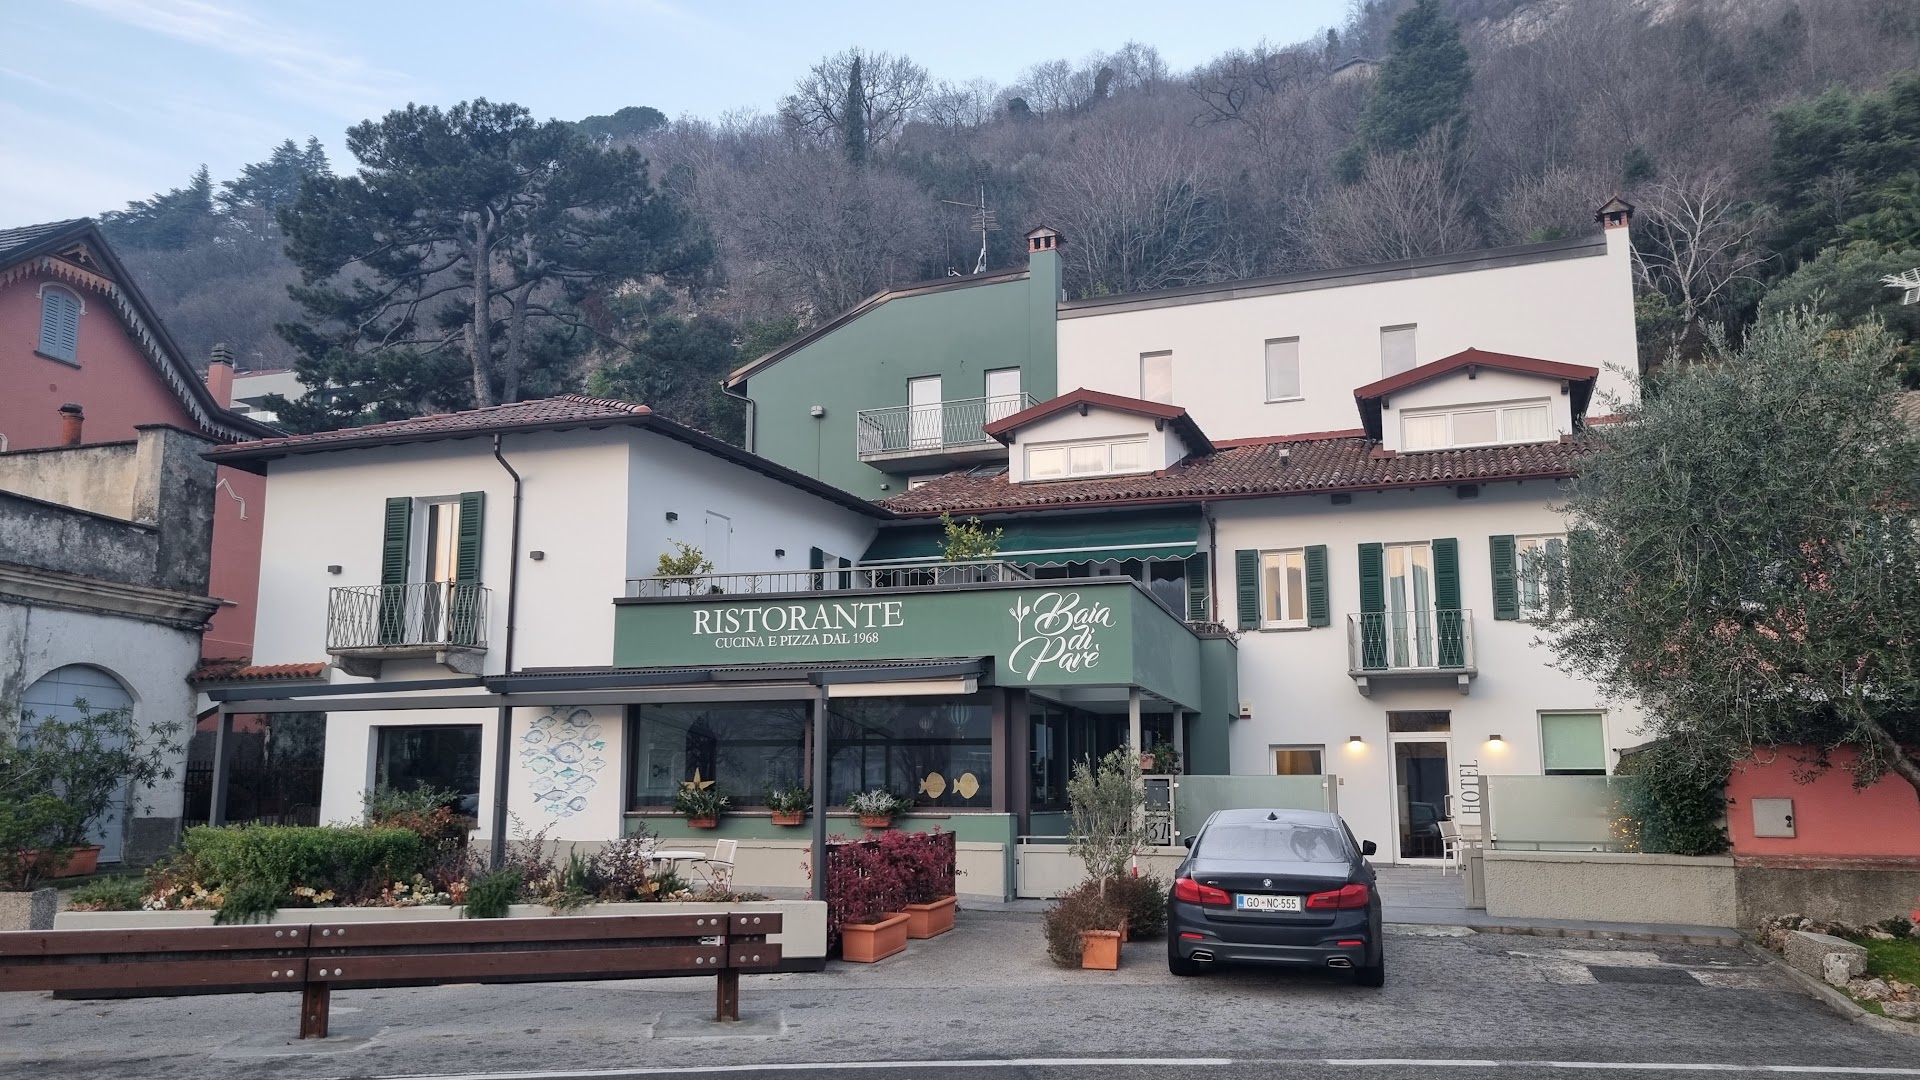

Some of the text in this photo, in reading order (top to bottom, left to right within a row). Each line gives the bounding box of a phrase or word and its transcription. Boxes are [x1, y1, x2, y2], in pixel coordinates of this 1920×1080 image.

[692, 601, 905, 635] RISTORANTE
[1033, 592, 1117, 636] Baia
[715, 632, 879, 649] CUCINA E PIZZA DAL 1968
[1067, 624, 1096, 651] di
[1008, 636, 1100, 682] Parè
[1459, 759, 1480, 814] HOTEL
[1246, 897, 1297, 909] GO NC-555
